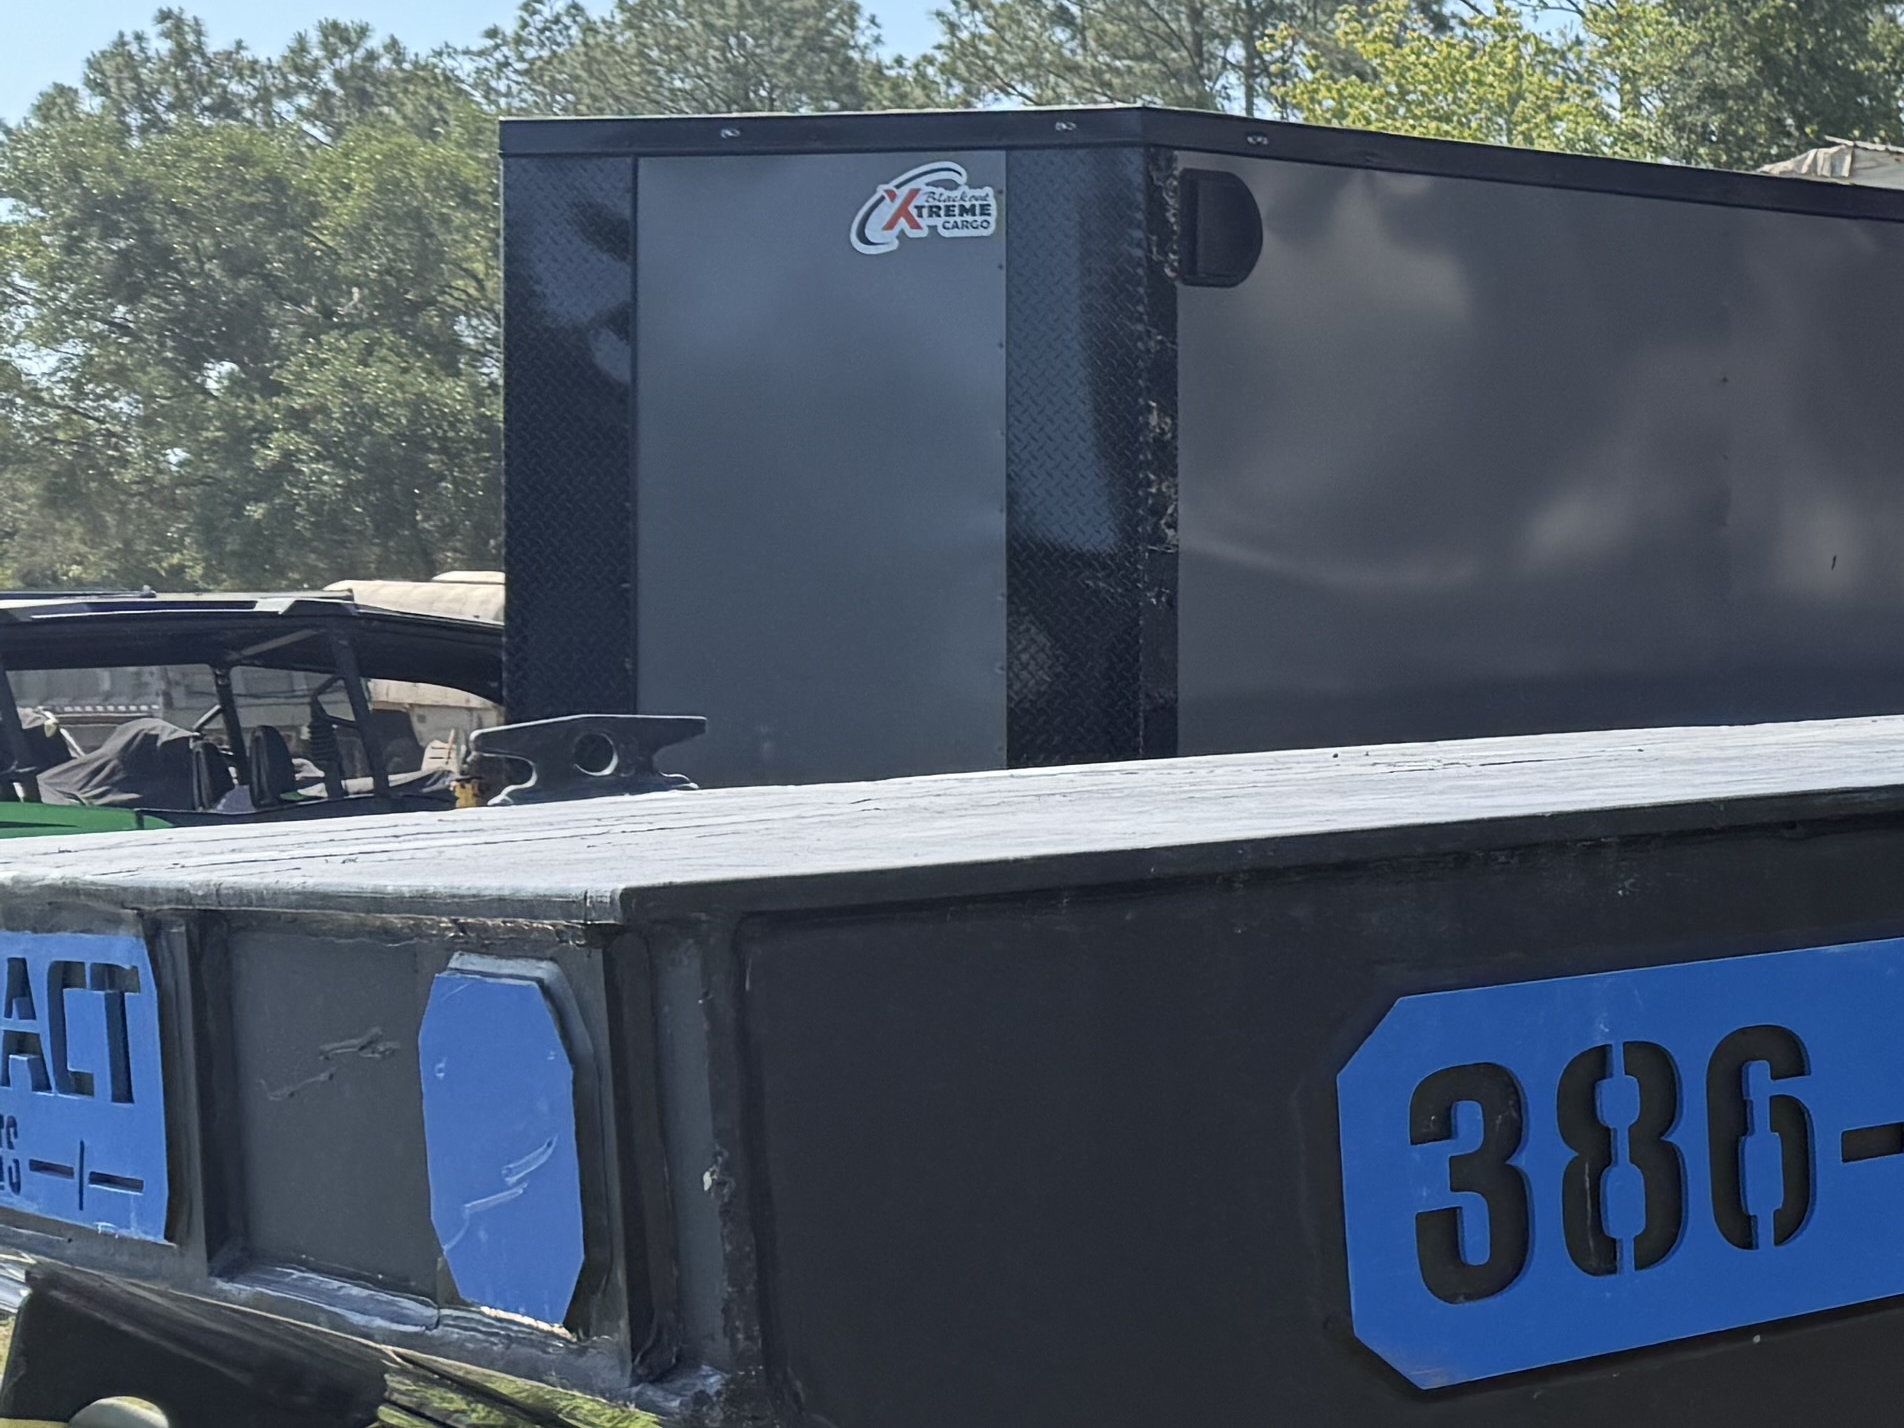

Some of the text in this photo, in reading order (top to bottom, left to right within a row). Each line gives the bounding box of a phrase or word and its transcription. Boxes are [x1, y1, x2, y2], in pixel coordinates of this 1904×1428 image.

[921, 190, 990, 204] Blackout
[882, 188, 992, 231] XTREME
[942, 219, 991, 231] CARGO
